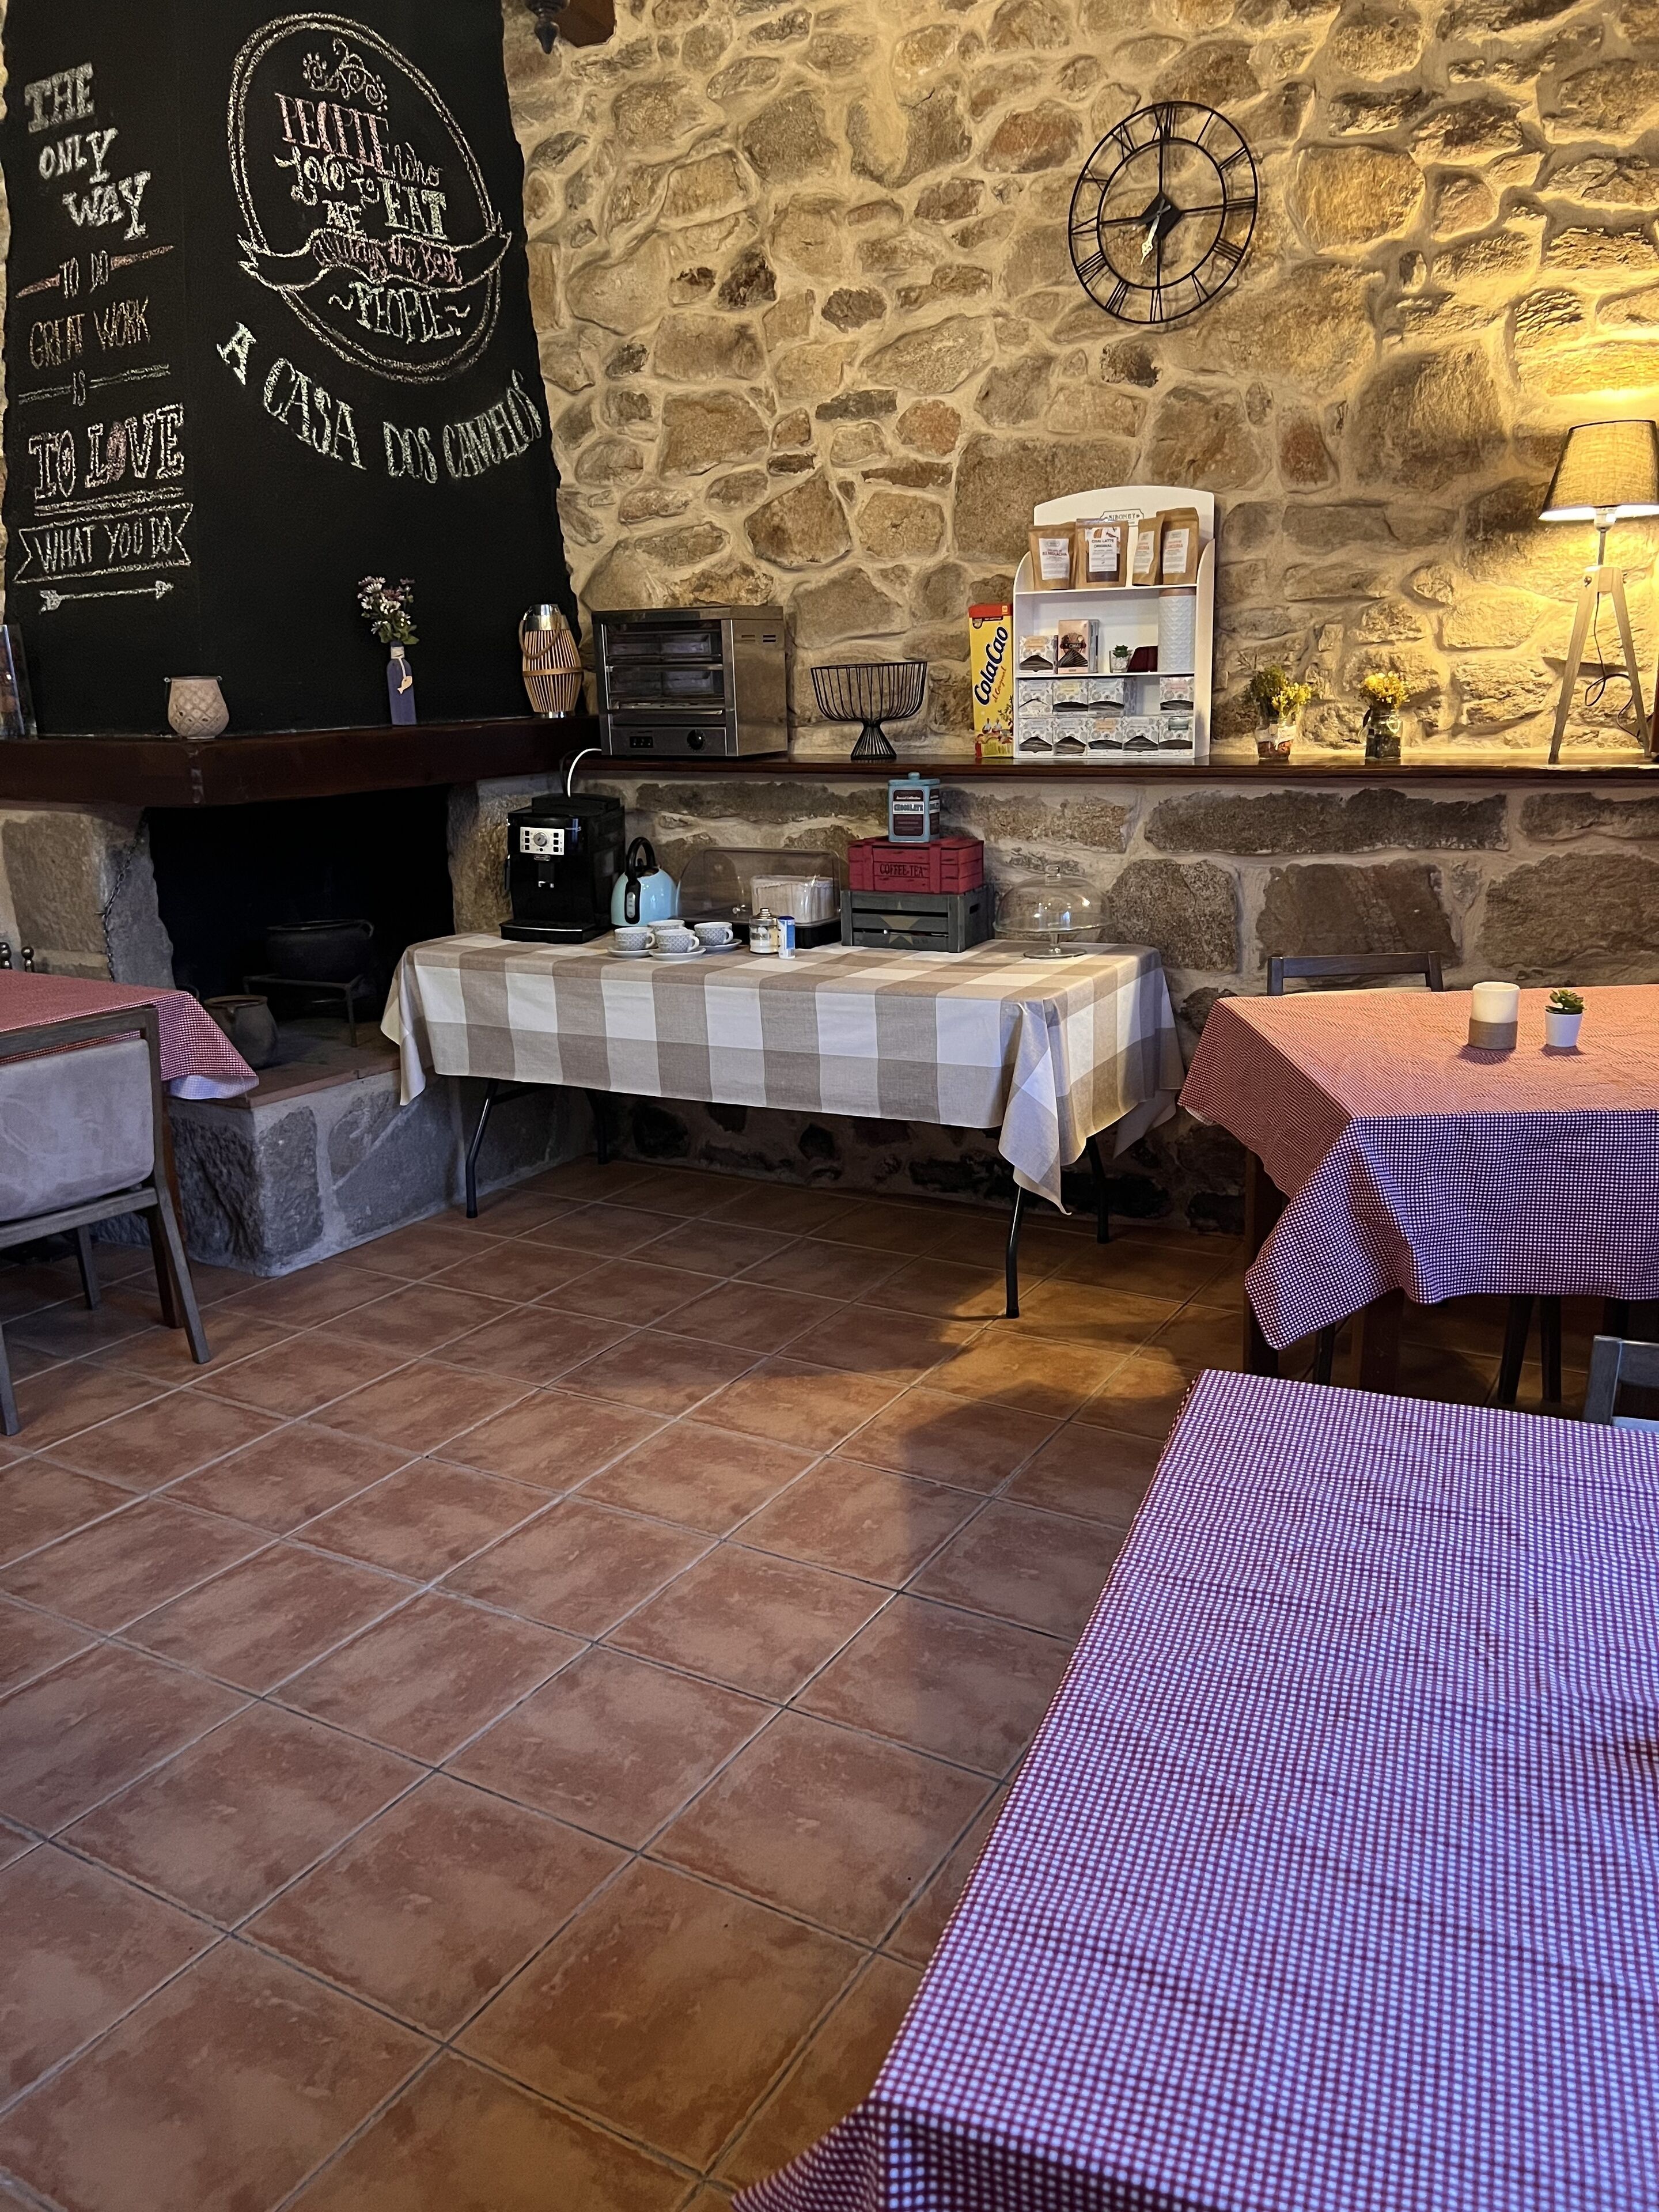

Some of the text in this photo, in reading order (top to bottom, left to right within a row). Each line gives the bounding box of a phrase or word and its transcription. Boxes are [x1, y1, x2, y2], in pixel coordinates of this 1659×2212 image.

[24, 62, 94, 133] THE
[39, 127, 119, 184] ONLY
[274, 92, 396, 179] PEOPLE
[62, 171, 151, 241] WAY
[377, 176, 448, 241] EAT
[59, 257, 79, 299] TO
[29, 296, 151, 369] GREAT WORK
[72, 369, 86, 406] IS
[216, 321, 257, 385] A
[263, 357, 367, 470] CASA
[382, 421, 438, 484] DOS
[28, 402, 184, 499] TO LOVE
[33, 513, 173, 574] WHAT YOU DO
